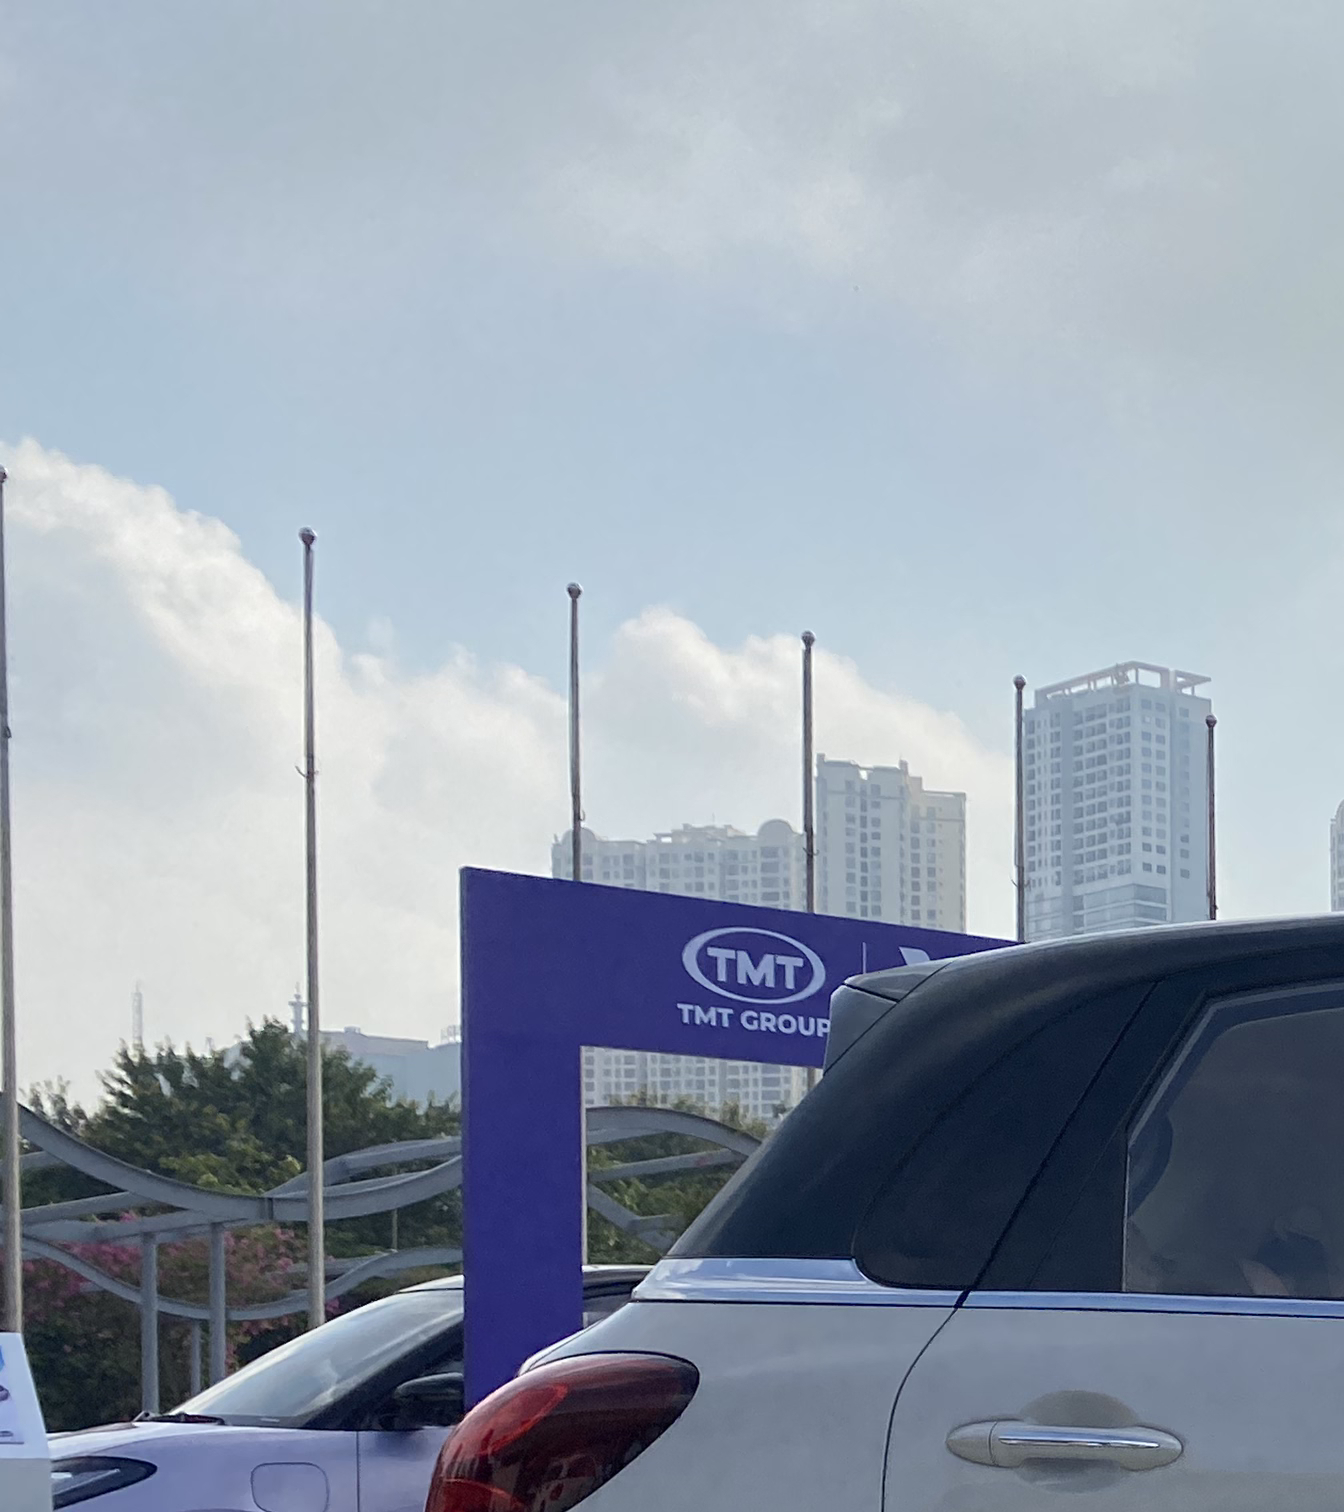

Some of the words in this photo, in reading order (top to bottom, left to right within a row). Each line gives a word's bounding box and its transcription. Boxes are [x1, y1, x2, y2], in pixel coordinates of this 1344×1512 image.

[707, 947, 804, 989] TMT
[677, 1003, 734, 1028] TMT
[740, 1010, 830, 1037] GROUP
